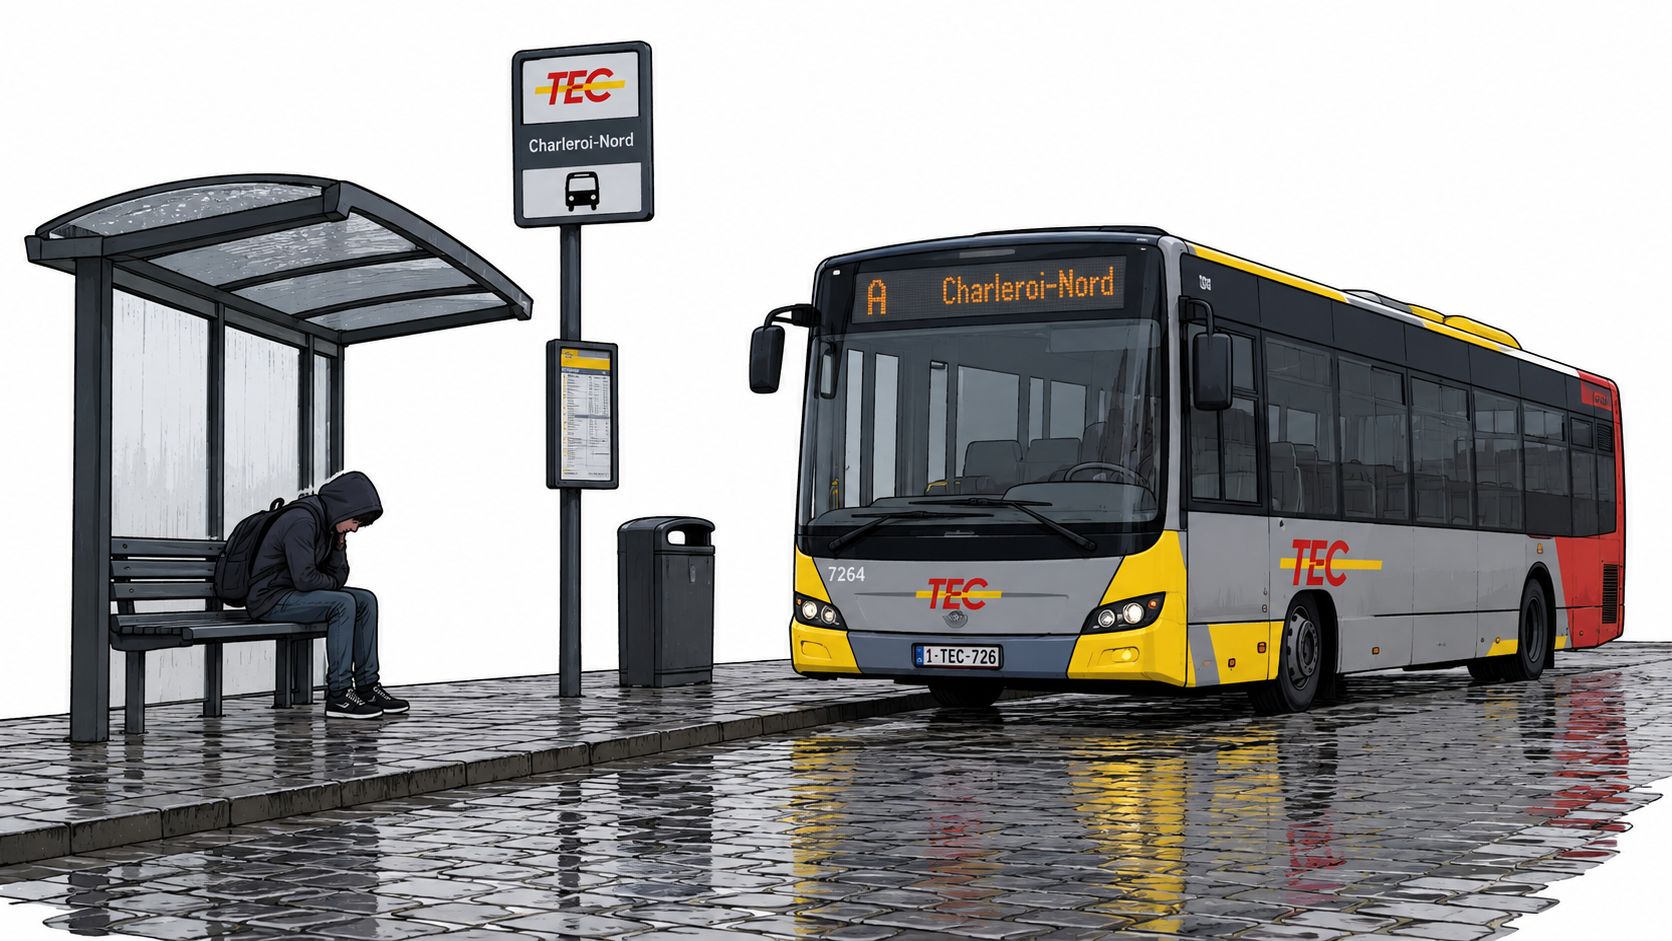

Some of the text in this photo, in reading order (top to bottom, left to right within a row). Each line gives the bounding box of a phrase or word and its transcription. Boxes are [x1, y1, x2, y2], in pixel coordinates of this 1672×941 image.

[547, 68, 614, 105] TEC
[528, 132, 634, 153] Charleroi-Nord
[867, 265, 1114, 316] A Charleroi-Nord
[828, 566, 865, 582] 7264
[1292, 539, 1350, 587] TEC
[928, 577, 988, 610] TEC
[926, 648, 997, 665] 1-TEC-726
